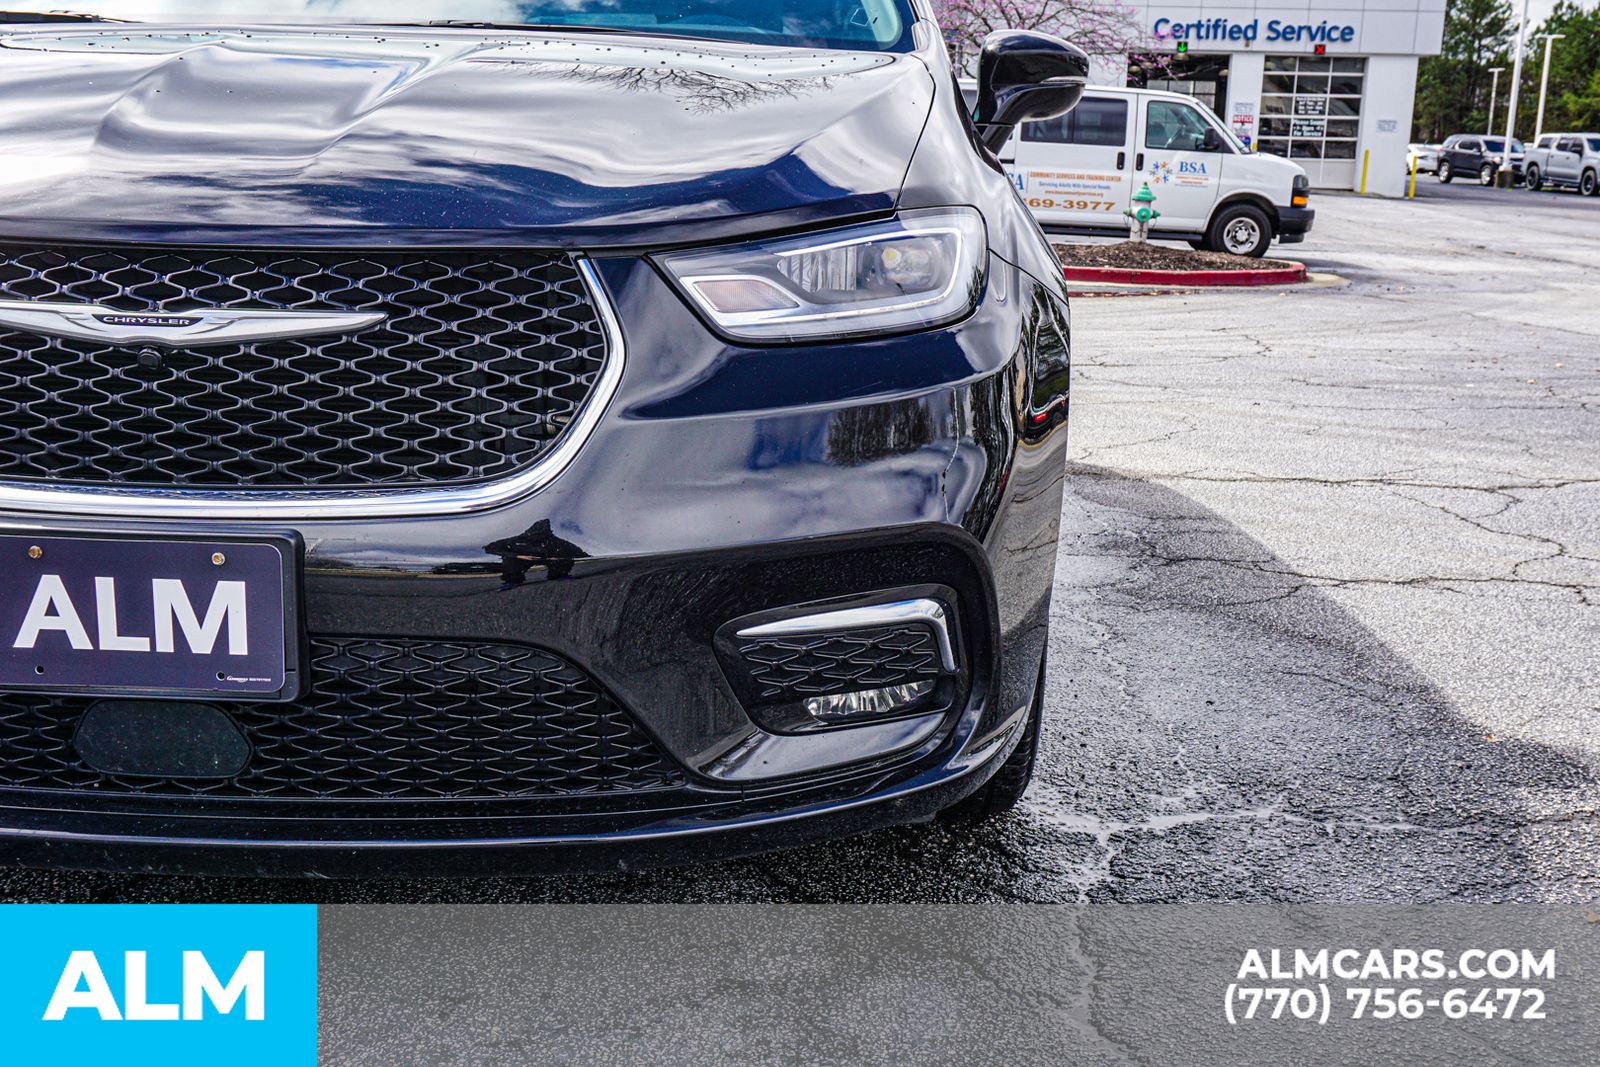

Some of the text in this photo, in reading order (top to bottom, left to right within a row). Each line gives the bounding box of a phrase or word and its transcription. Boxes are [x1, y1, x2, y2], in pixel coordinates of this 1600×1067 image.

[1154, 18, 1355, 42] Certified Service
[1180, 161, 1207, 174] BSA
[103, 316, 190, 325] CHRYSLER
[12, 574, 249, 656] ALM
